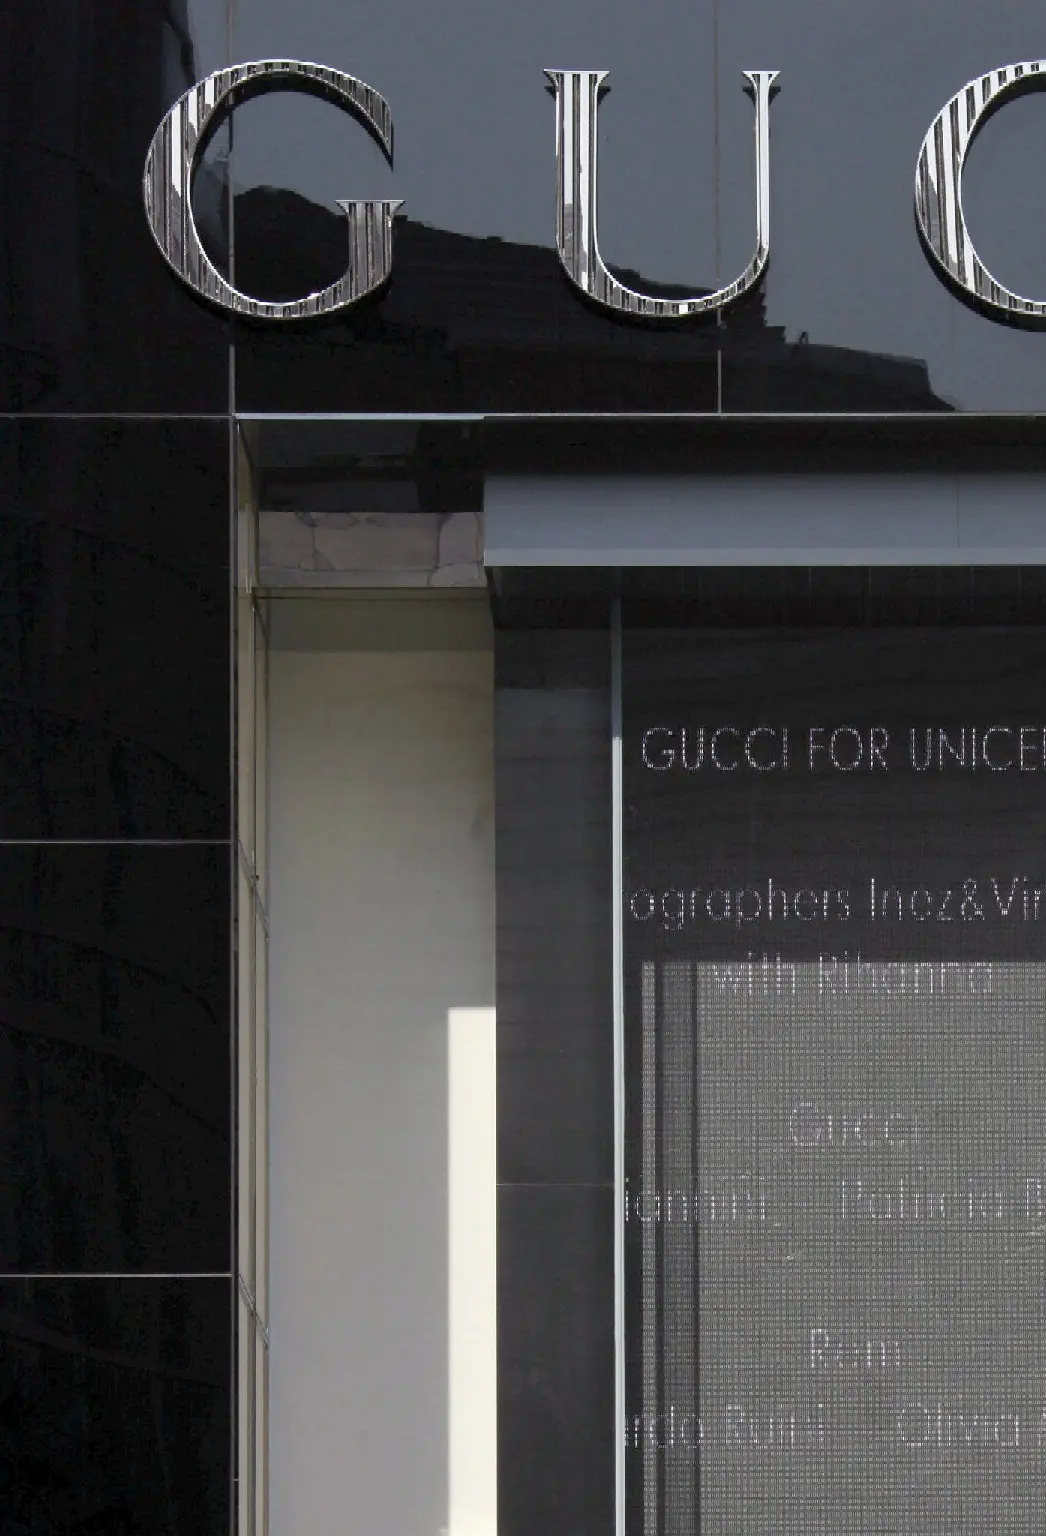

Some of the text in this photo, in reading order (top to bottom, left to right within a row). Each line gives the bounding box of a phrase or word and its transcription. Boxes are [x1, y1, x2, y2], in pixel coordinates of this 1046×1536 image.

[642, 727, 789, 771] GUCCI
[809, 727, 890, 770] FOR
[630, 878, 850, 930] ographers
[817, 951, 993, 994] Rihanna
[789, 1102, 918, 1146] Gucci
